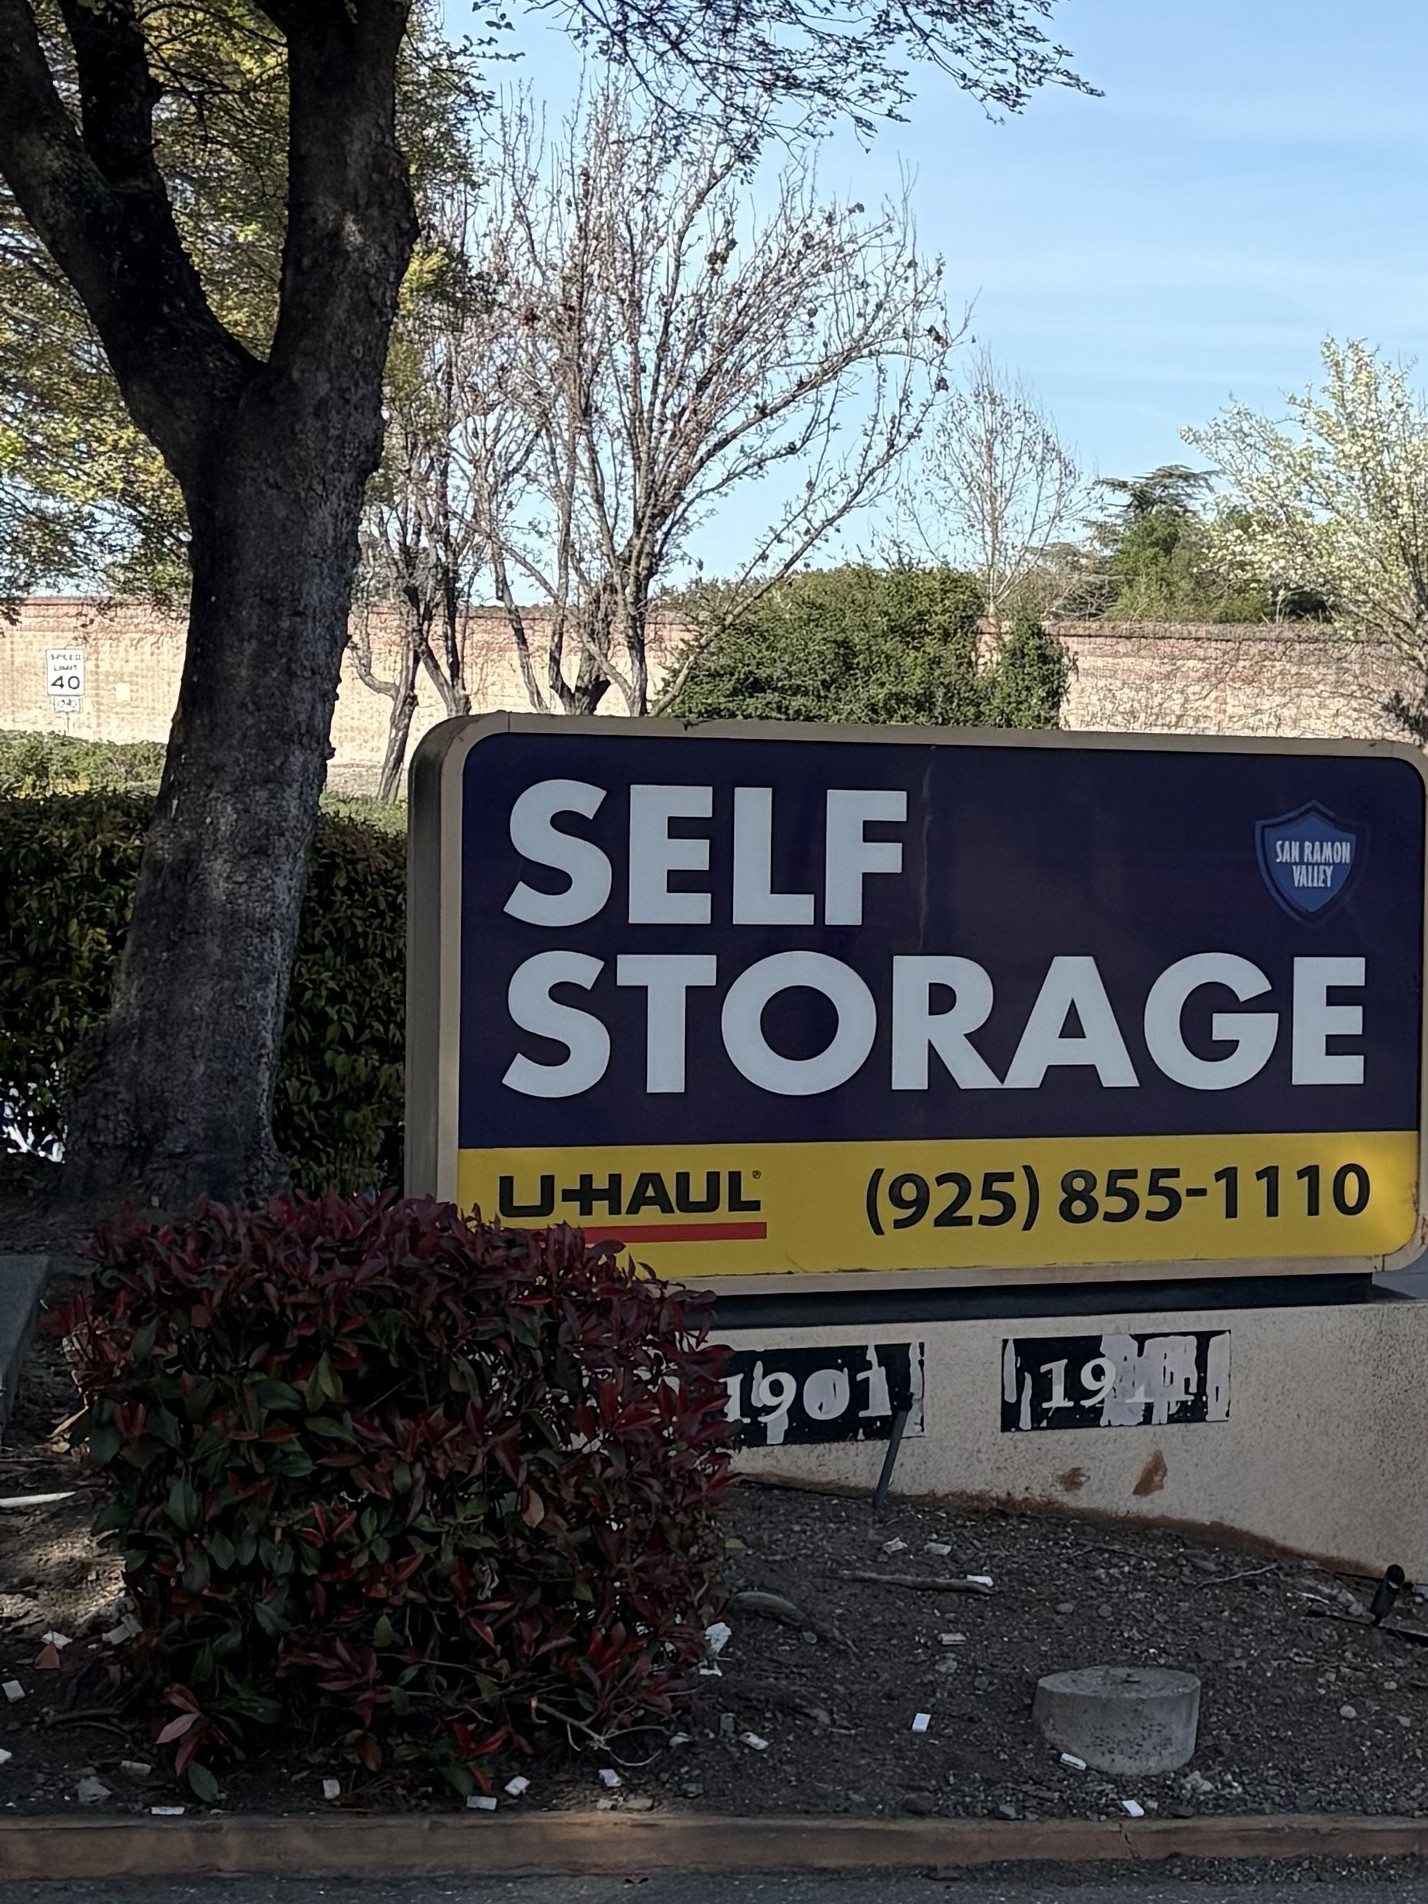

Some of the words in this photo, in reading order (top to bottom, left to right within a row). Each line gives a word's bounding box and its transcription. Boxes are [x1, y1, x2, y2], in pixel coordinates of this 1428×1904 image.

[50, 675, 81, 690] 40
[502, 778, 908, 927] SELF
[1275, 840, 1300, 863] SAN
[1303, 840, 1351, 864] RAMON
[1292, 864, 1334, 888] VALLEY
[501, 949, 1367, 1099] STORAGE
[498, 1170, 762, 1218] U-HAUL
[865, 1164, 1040, 1236] (925)
[1058, 1163, 1372, 1225] 855-1110
[718, 1365, 893, 1424] 1901
